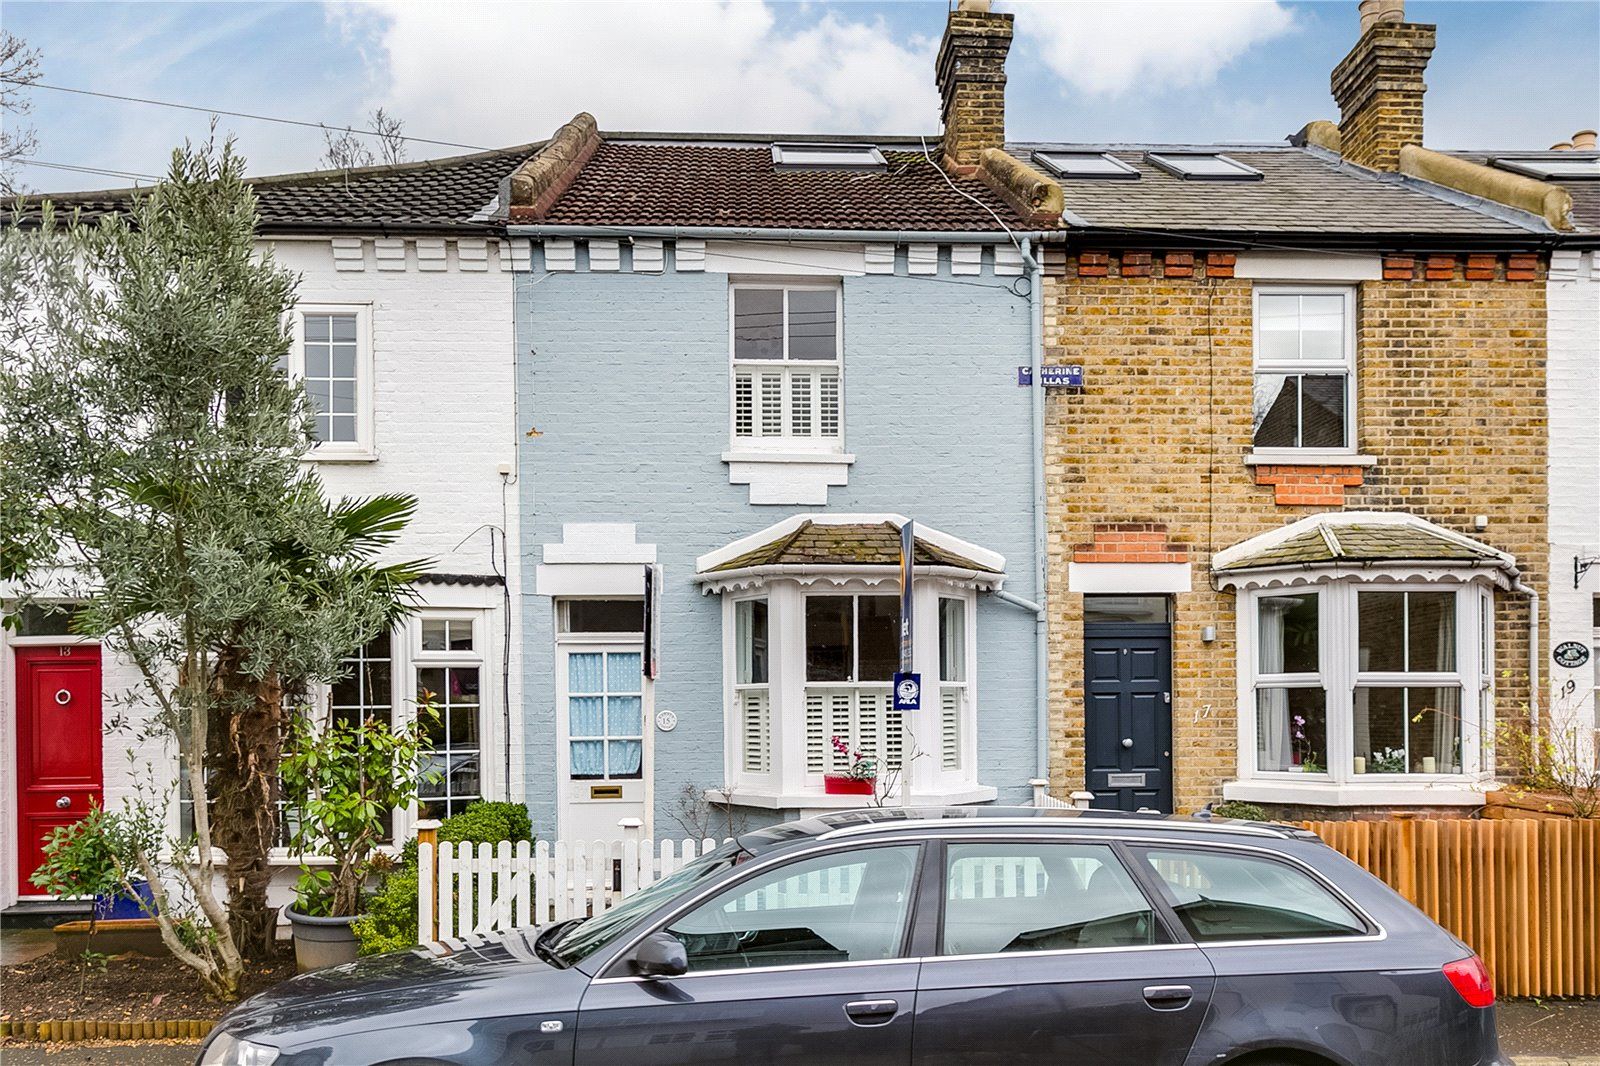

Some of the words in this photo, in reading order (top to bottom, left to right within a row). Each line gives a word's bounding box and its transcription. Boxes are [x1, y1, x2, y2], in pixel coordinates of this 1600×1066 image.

[1021, 367, 1080, 375] CHERINE
[60, 646, 71, 656] 13
[1561, 680, 1575, 699] 19
[1193, 704, 1212, 724] 17
[662, 717, 672, 725] 15
